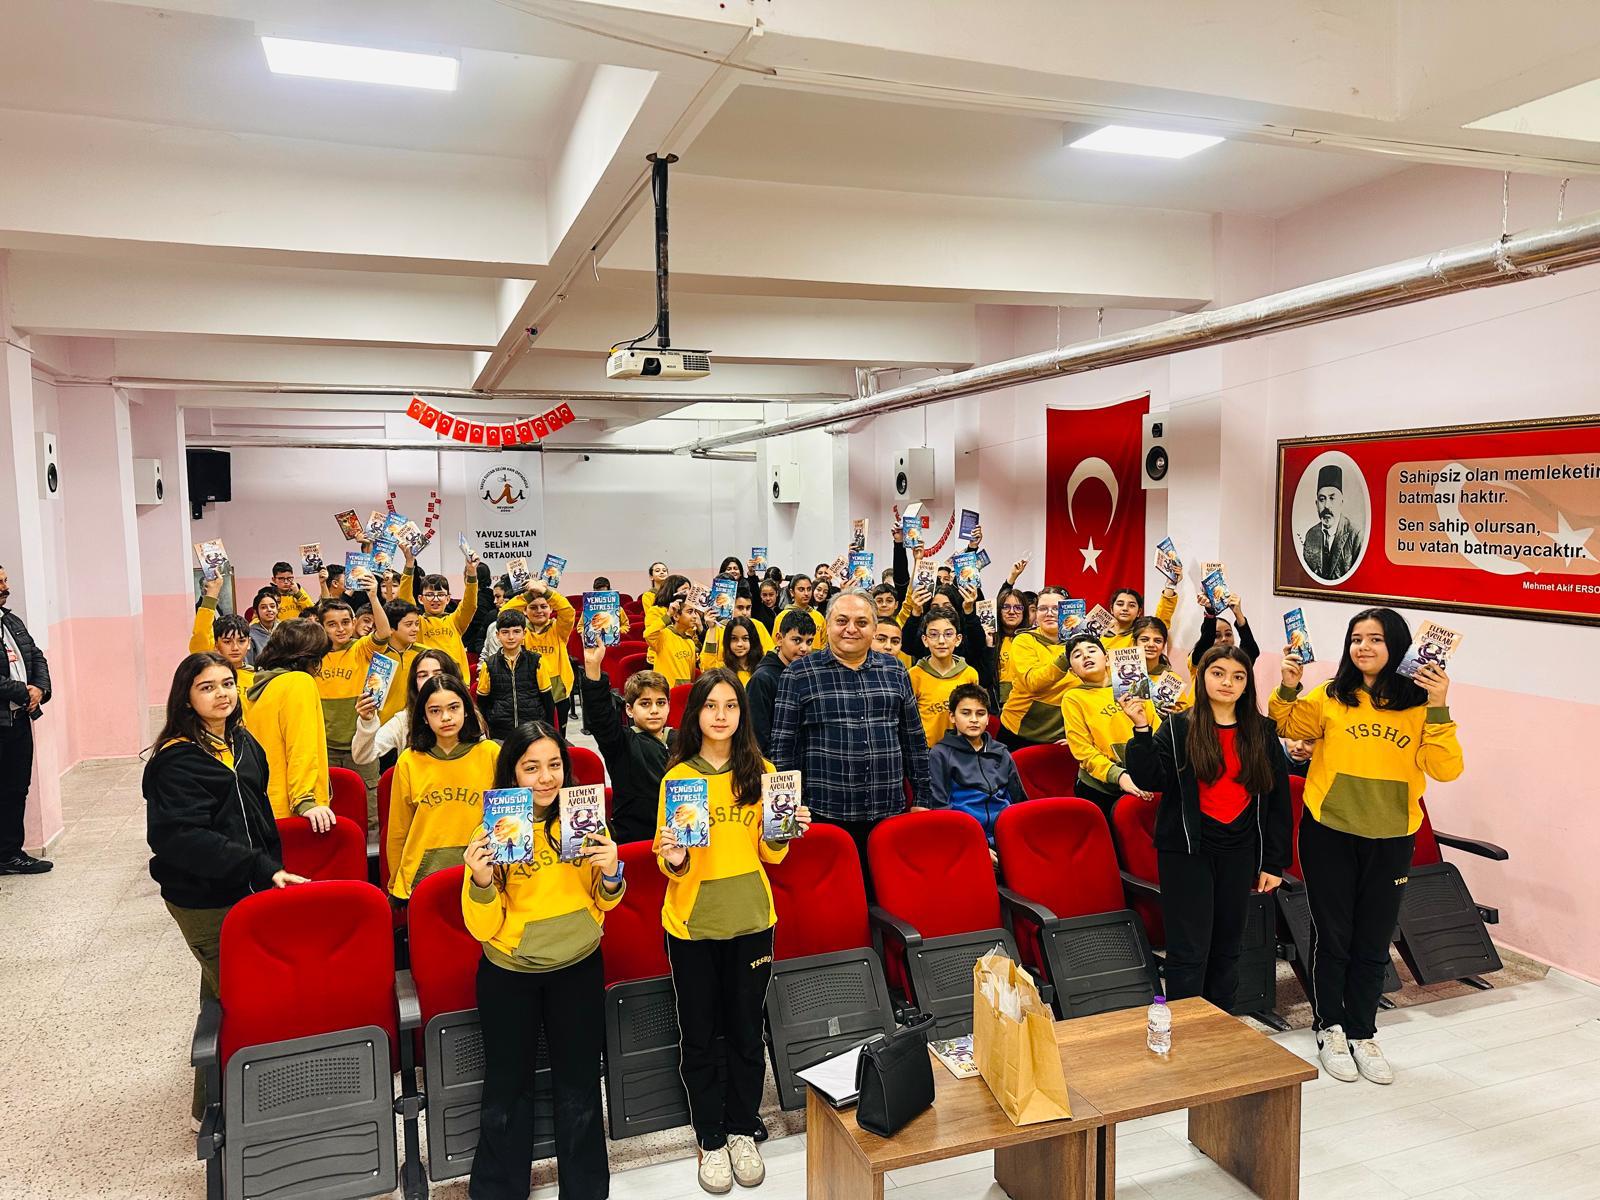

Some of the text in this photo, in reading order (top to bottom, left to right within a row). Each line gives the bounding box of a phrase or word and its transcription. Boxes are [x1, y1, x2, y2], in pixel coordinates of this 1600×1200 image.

[1399, 468, 1461, 485] Sahipsiz
[1465, 468, 1499, 482] olan
[1398, 490, 1508, 504] batması haktır.
[475, 530, 537, 538] YAVUZ SULTAN
[1398, 518, 1541, 536] Sen sahip olursan,
[484, 540, 529, 549] SELİM HAN
[1397, 539, 1586, 559] bu vatan batmayacaktır.
[482, 550, 532, 559] ORTAOKULU
[1522, 581, 1555, 591] Mehmet
[1556, 584, 1573, 592] Akif
[928, 700, 950, 715] YSS
[1100, 701, 1124, 717] YSS
[1345, 723, 1411, 749] YSSHO
[421, 787, 480, 808] YSSHO
[488, 792, 528, 805] VENÜS'ÜN
[568, 787, 597, 798] ELEMENT
[567, 795, 598, 807] AVCILARI
[708, 805, 755, 827] SSHO
